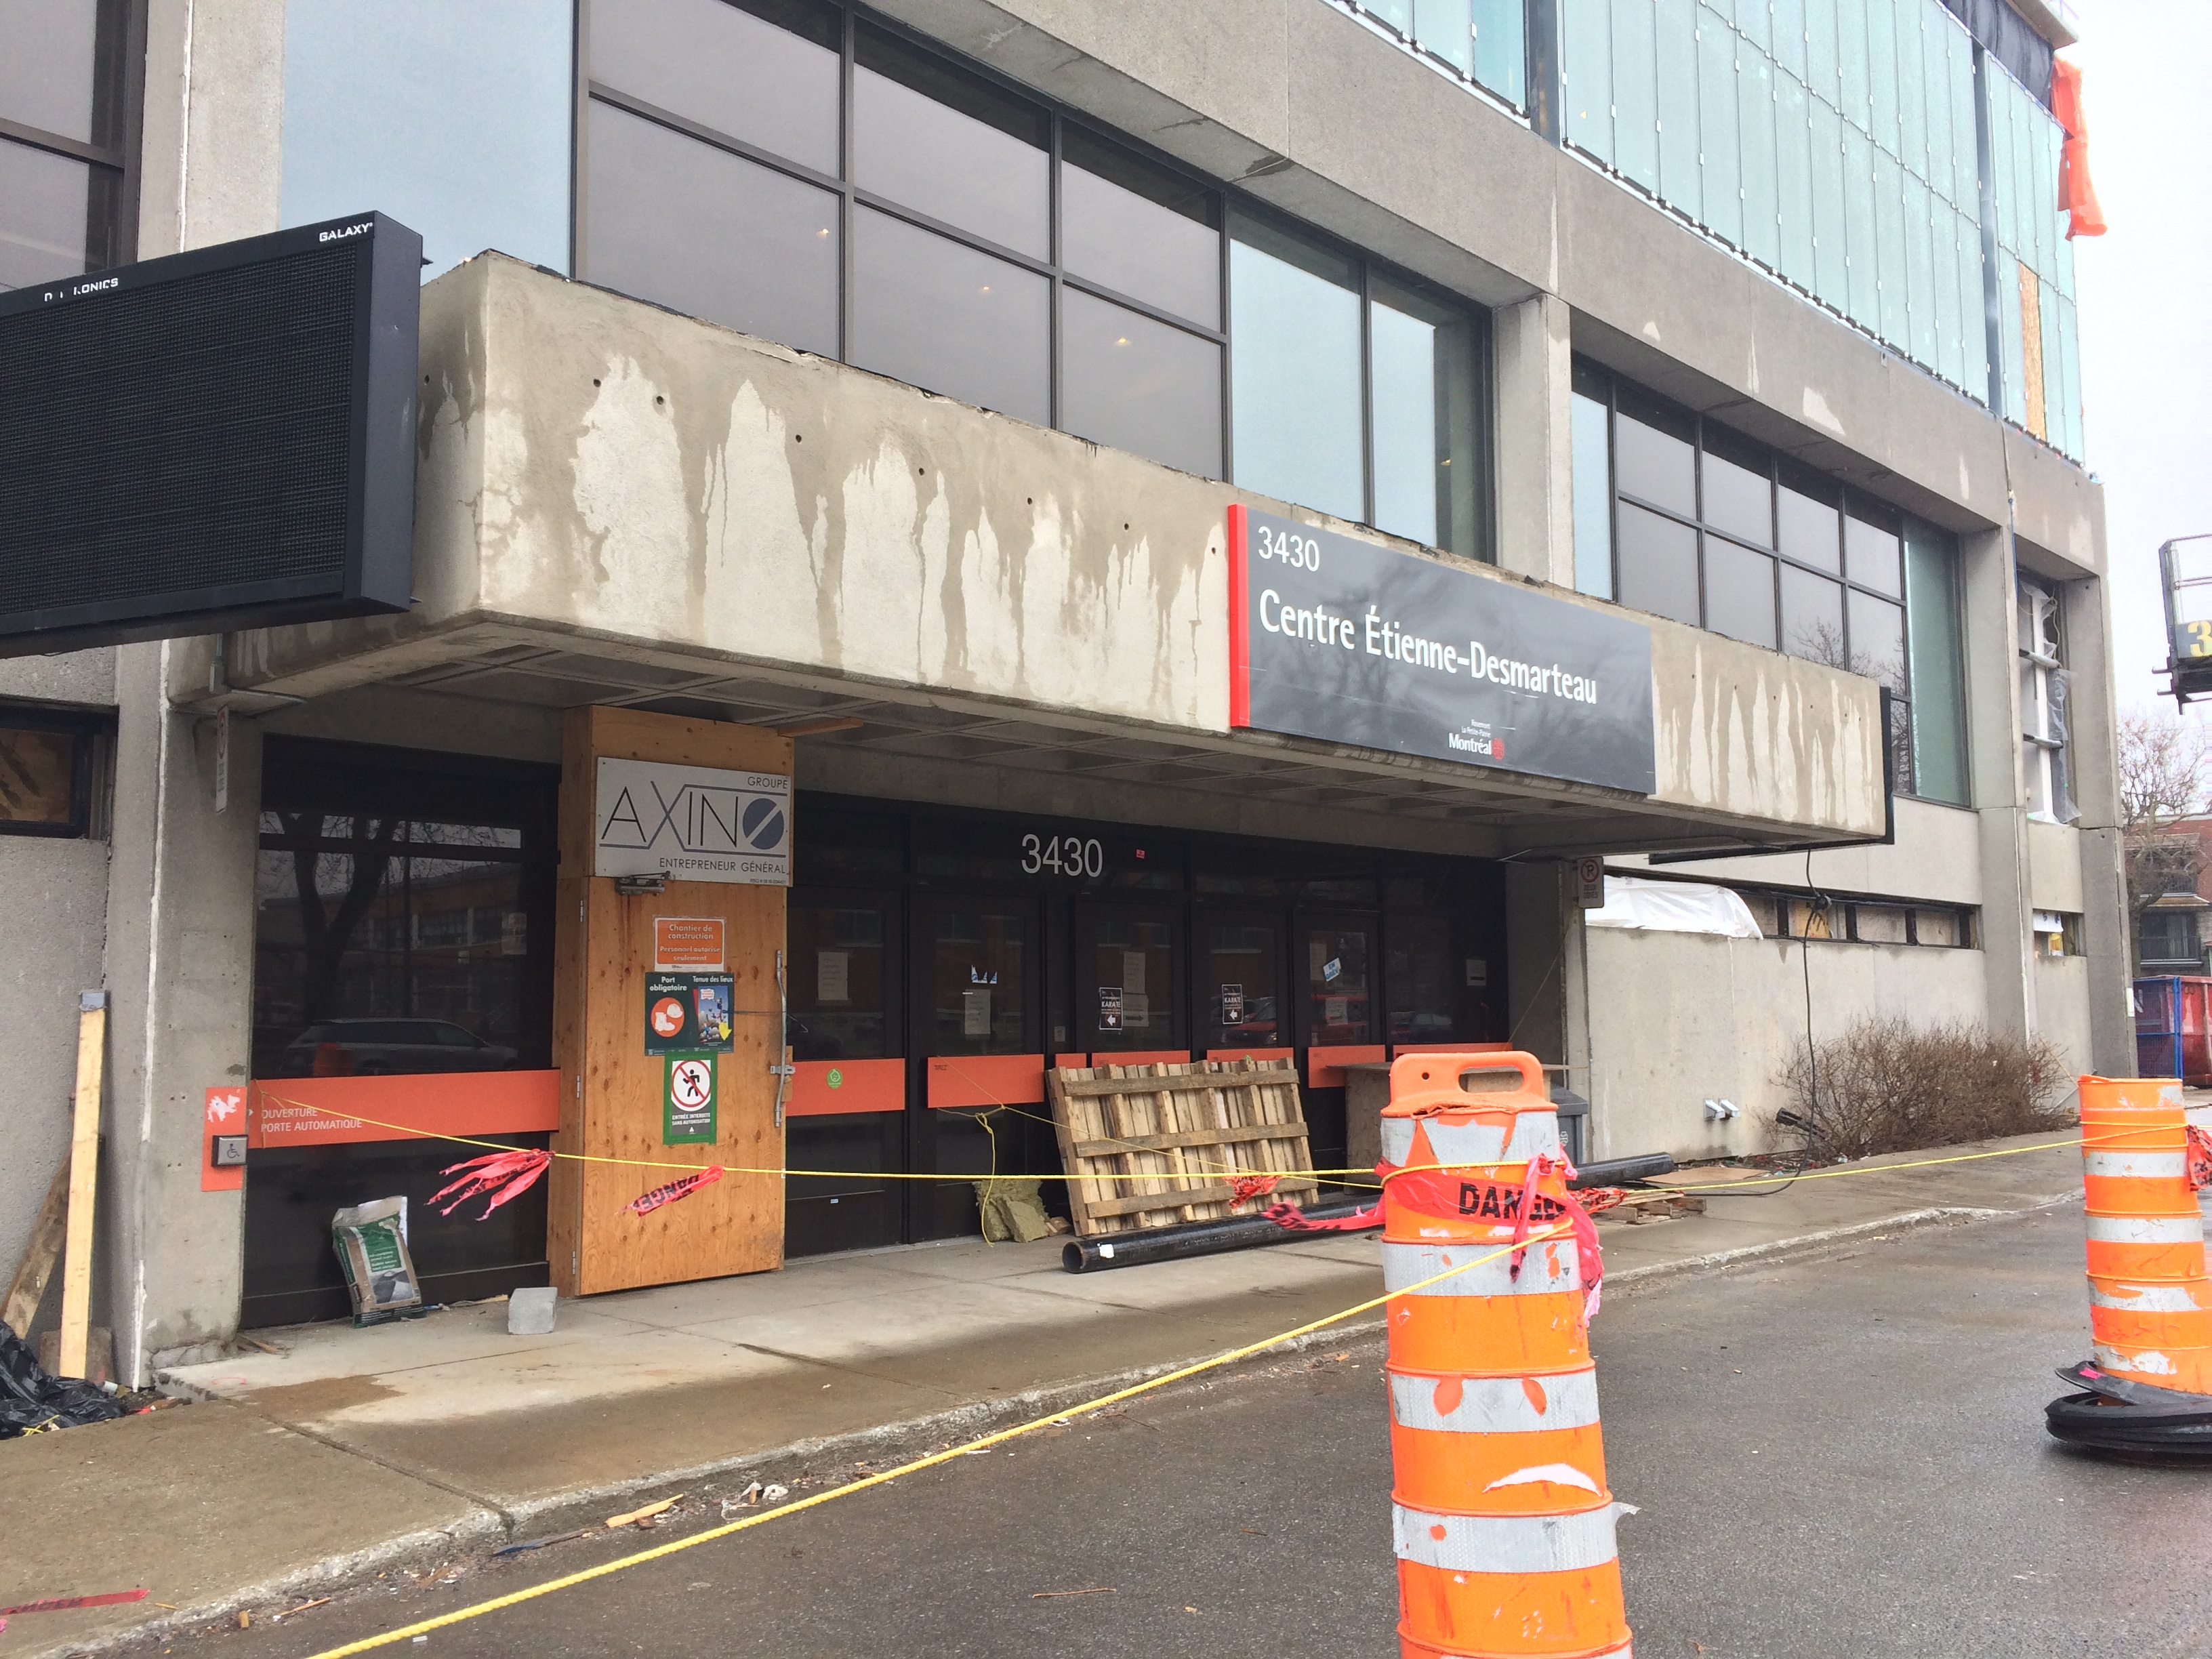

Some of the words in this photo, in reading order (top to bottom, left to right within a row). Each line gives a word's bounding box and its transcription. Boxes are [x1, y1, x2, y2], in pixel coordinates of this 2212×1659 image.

[1258, 526, 1319, 573] 3430
[1259, 589, 1356, 650] Centre
[1365, 605, 1597, 705] Étienne-Desmarteau
[1448, 733, 1492, 756] Montréal
[747, 777, 788, 789] GROUPE
[1021, 834, 1103, 878] 3430
[659, 858, 736, 872] ENTREPRENEUR
[741, 862, 786, 874] GÉNÉRAL
[649, 984, 688, 993] obligatoire
[262, 1108, 318, 1119] OUVERTURE
[260, 1122, 291, 1132] PORTE
[293, 1120, 363, 1131] AUTOMATIQUE
